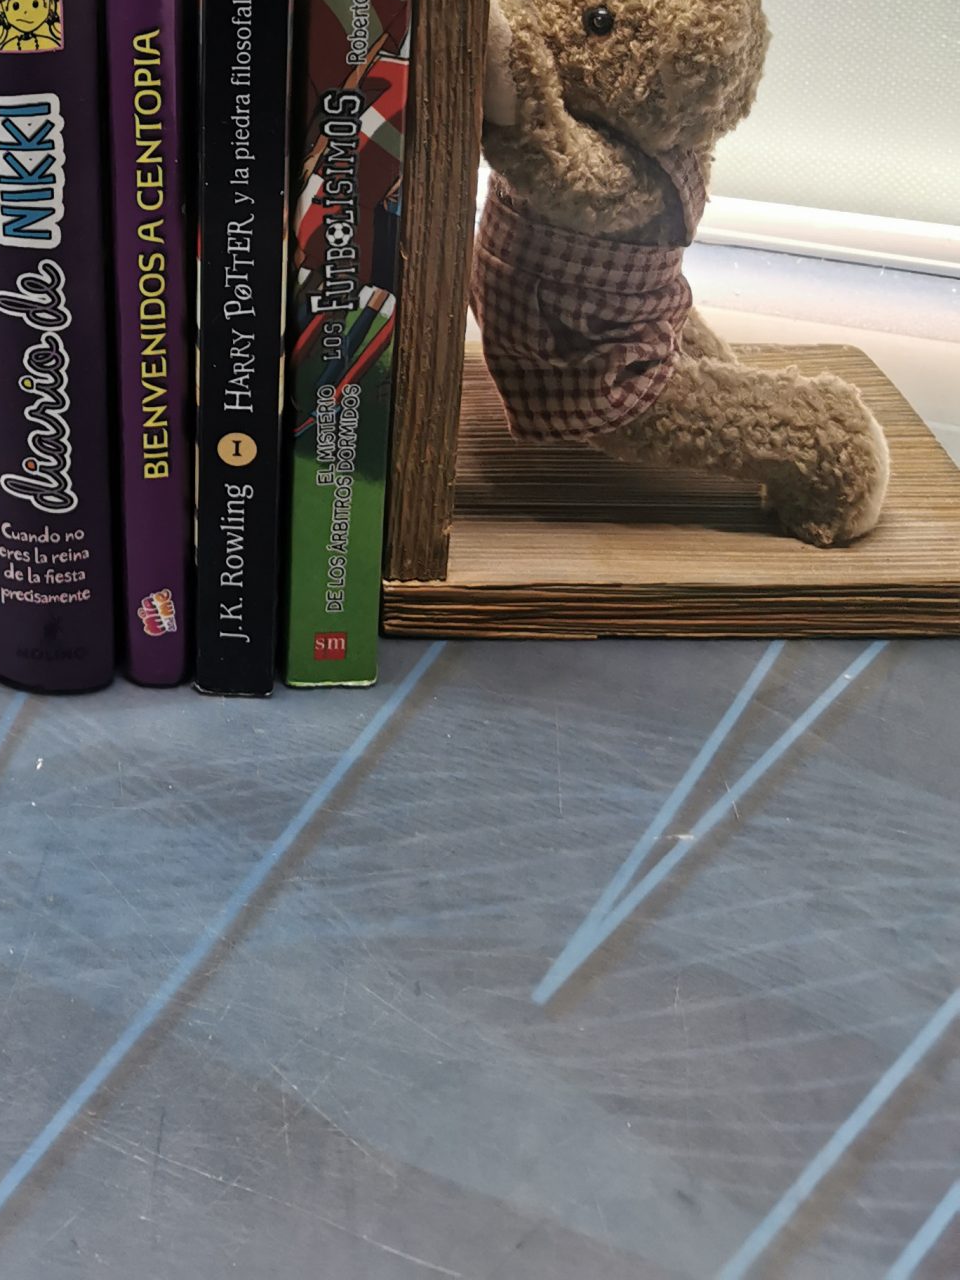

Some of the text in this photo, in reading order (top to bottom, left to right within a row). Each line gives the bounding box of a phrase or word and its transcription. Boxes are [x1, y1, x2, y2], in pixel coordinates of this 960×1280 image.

[231, 0, 253, 86] filosofal
[231, 94, 255, 160] piedra
[230, 167, 250, 185] la
[234, 191, 255, 204] y
[132, 28, 169, 479] BIENVENIDOS A CENTOPIA
[323, 323, 343, 361] LOS
[223, 328, 255, 413] HARRY
[0, 331, 78, 513] diario
[317, 384, 336, 486] EL MISTERIO
[336, 383, 361, 472] DORMIDOS
[0, 521, 85, 543] Cuando no
[220, 483, 254, 587] Rowling
[3, 562, 86, 584] de la fiesta
[34, 547, 48, 564] la
[51, 548, 90, 564] reina
[327, 554, 347, 588] LOS
[0, 586, 91, 604] precisamente
[326, 589, 343, 612] DE
[219, 596, 251, 643] J.K.
[315, 638, 346, 651] sm
